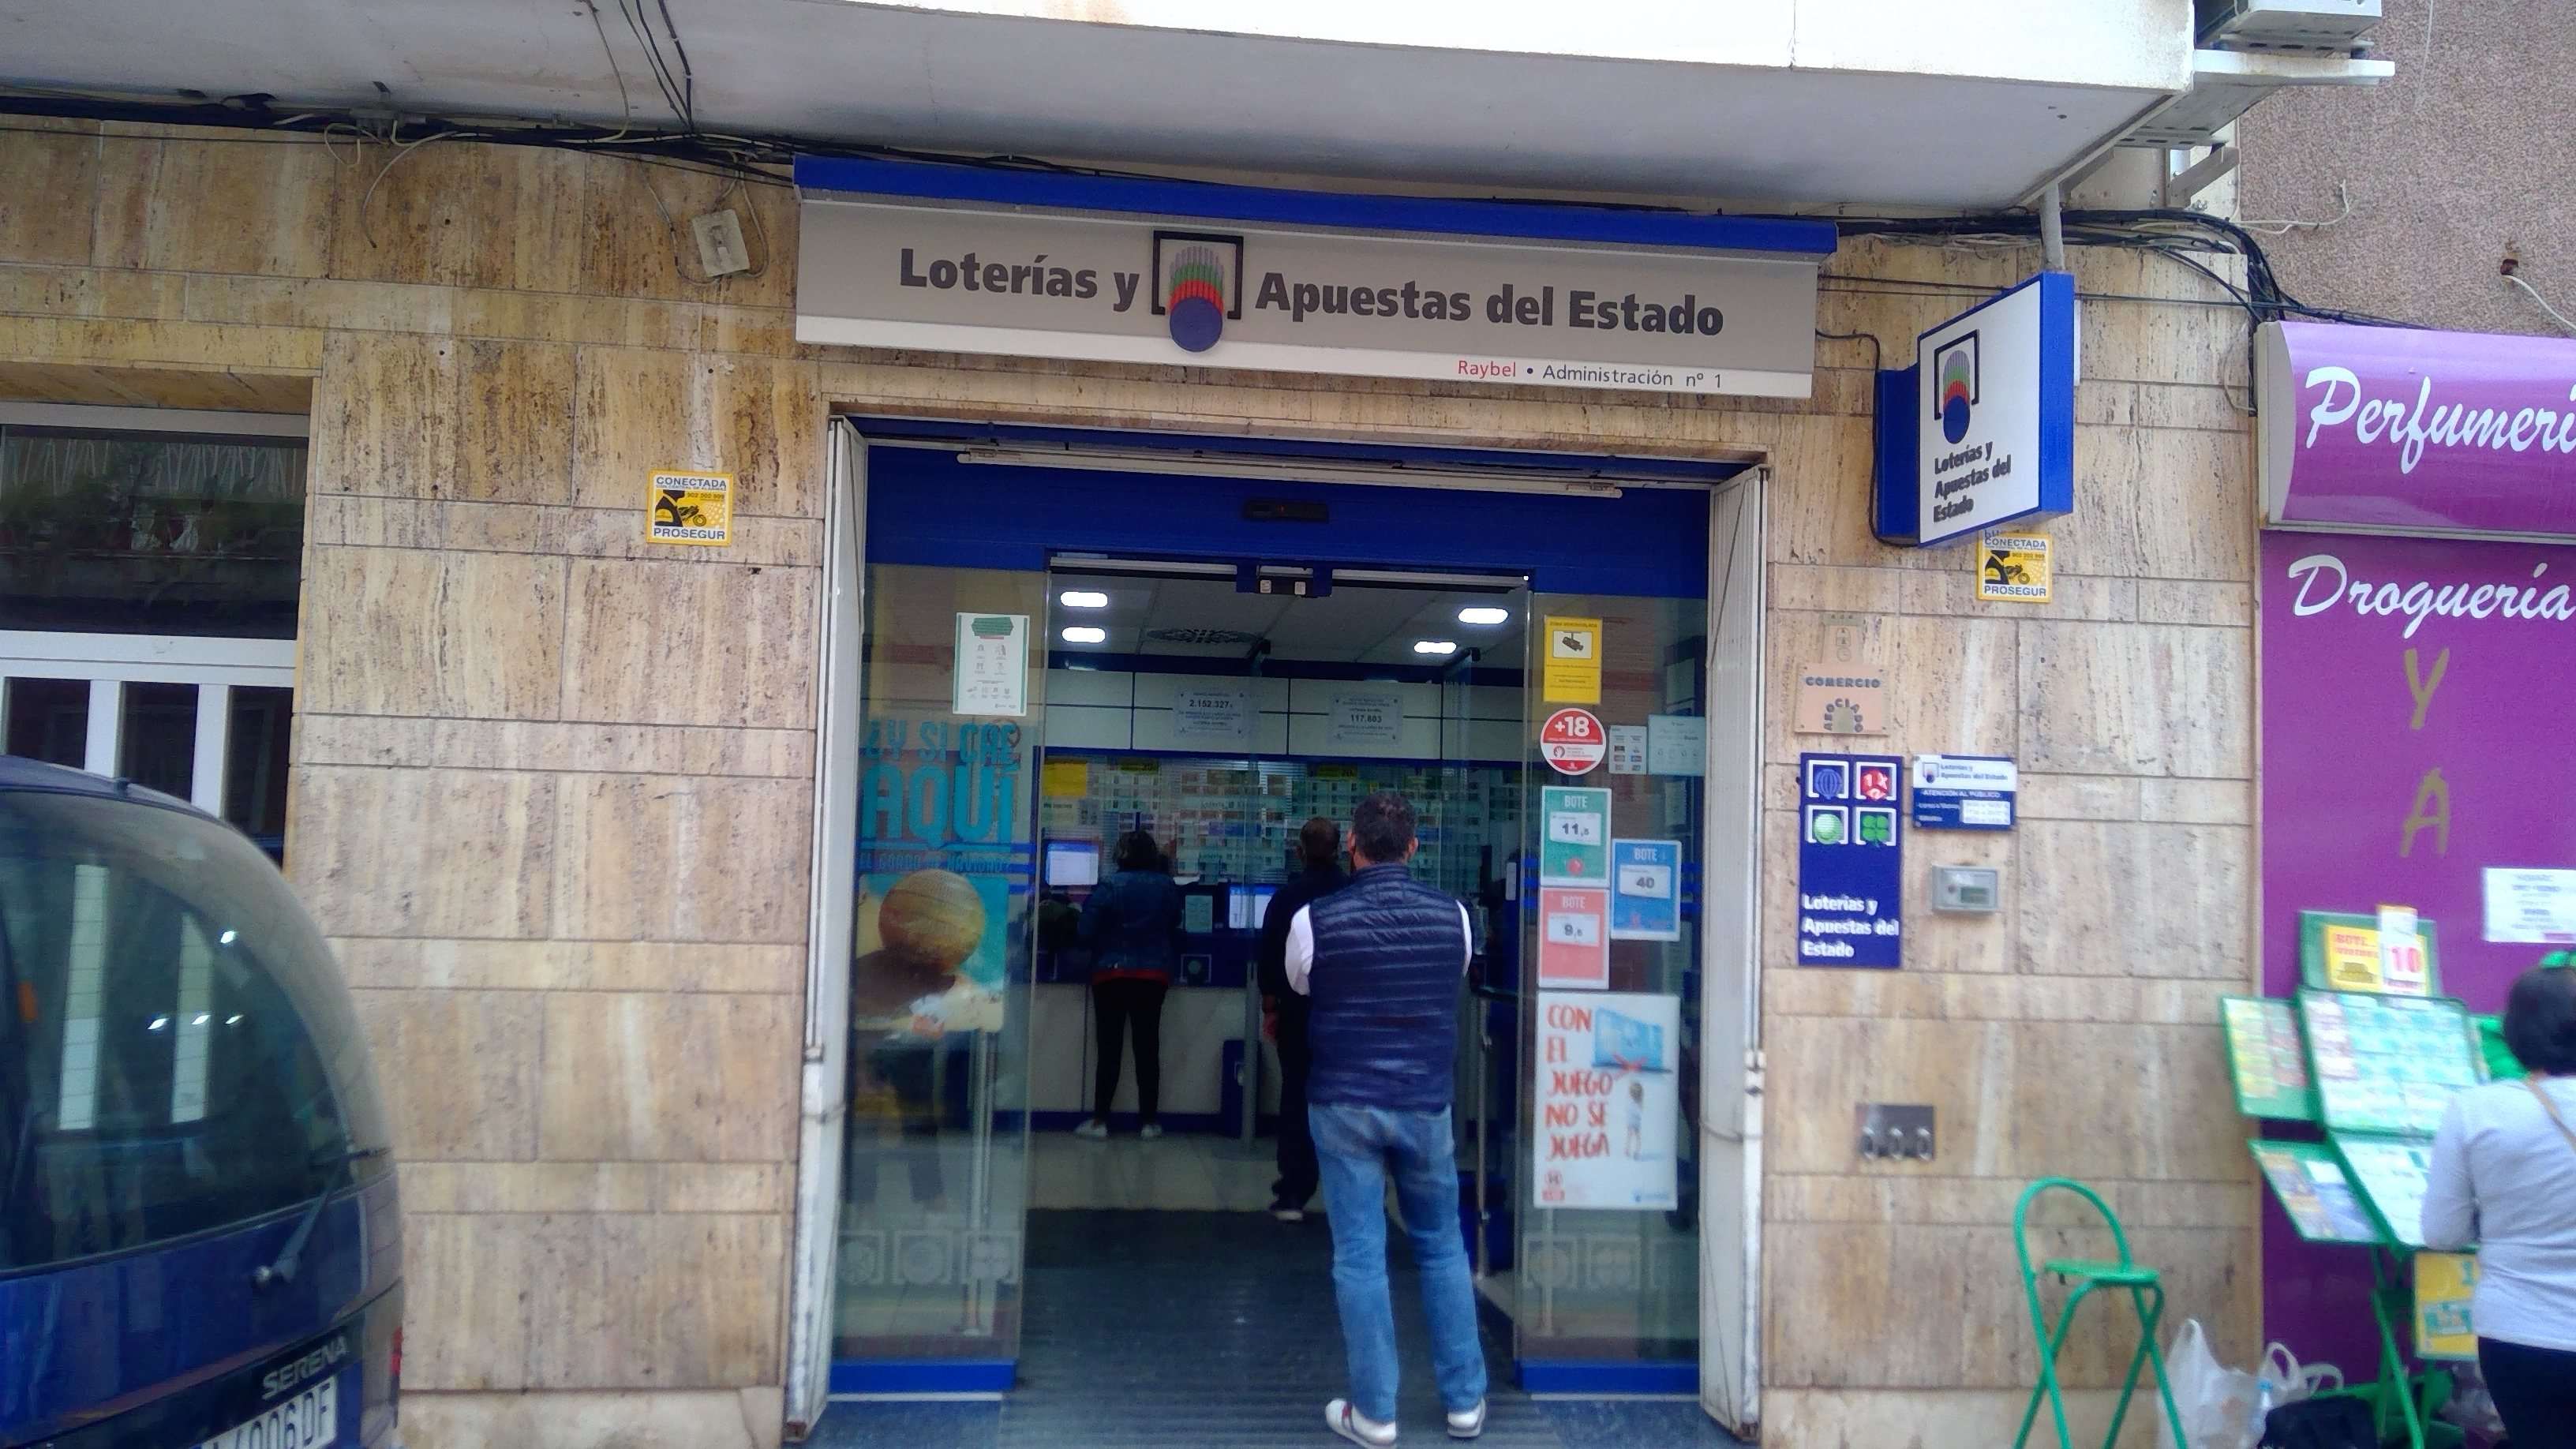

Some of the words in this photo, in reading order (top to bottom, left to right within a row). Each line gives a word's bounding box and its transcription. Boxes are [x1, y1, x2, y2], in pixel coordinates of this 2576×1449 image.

[900, 249, 1098, 299] Loterías
[1113, 271, 1140, 313] y
[1255, 272, 1471, 322] Apuestas
[1486, 283, 1554, 327] del
[1569, 290, 1724, 336] Estado
[1457, 360, 1517, 379] Raybel
[1542, 363, 1673, 387] Administración
[1714, 373, 1722, 388] 1
[1934, 444, 1983, 475] Loterías
[1985, 441, 1993, 462] y
[656, 477, 726, 489] CONECTADA
[1934, 467, 1989, 500] Apuestas
[1992, 454, 2011, 478] del
[1934, 495, 1974, 522] Estado
[653, 528, 725, 540] PROSEGUR
[1984, 537, 2046, 548] CONECTADA
[1984, 586, 2046, 597] PROSEGUR
[1805, 676, 1881, 688] COMERCIO
[1554, 716, 1590, 737] +18
[1564, 796, 1589, 808] BOTE
[1634, 848, 1658, 861] BOTE
[1636, 877, 1655, 889] 40
[1563, 897, 1586, 909] BOTE
[1803, 893, 1865, 911] Loterías
[1866, 899, 1878, 915] y
[1803, 917, 1872, 937] Apuestas
[1874, 918, 1899, 936] del
[1802, 940, 1855, 957] Estado
[1547, 1004, 1592, 1032] CON
[1548, 1069, 1613, 1096] JUEGO
[1544, 1103, 1578, 1128] NO
[1545, 1133, 1610, 1161] JUEGA
[262, 1335, 347, 1401] SERENA
